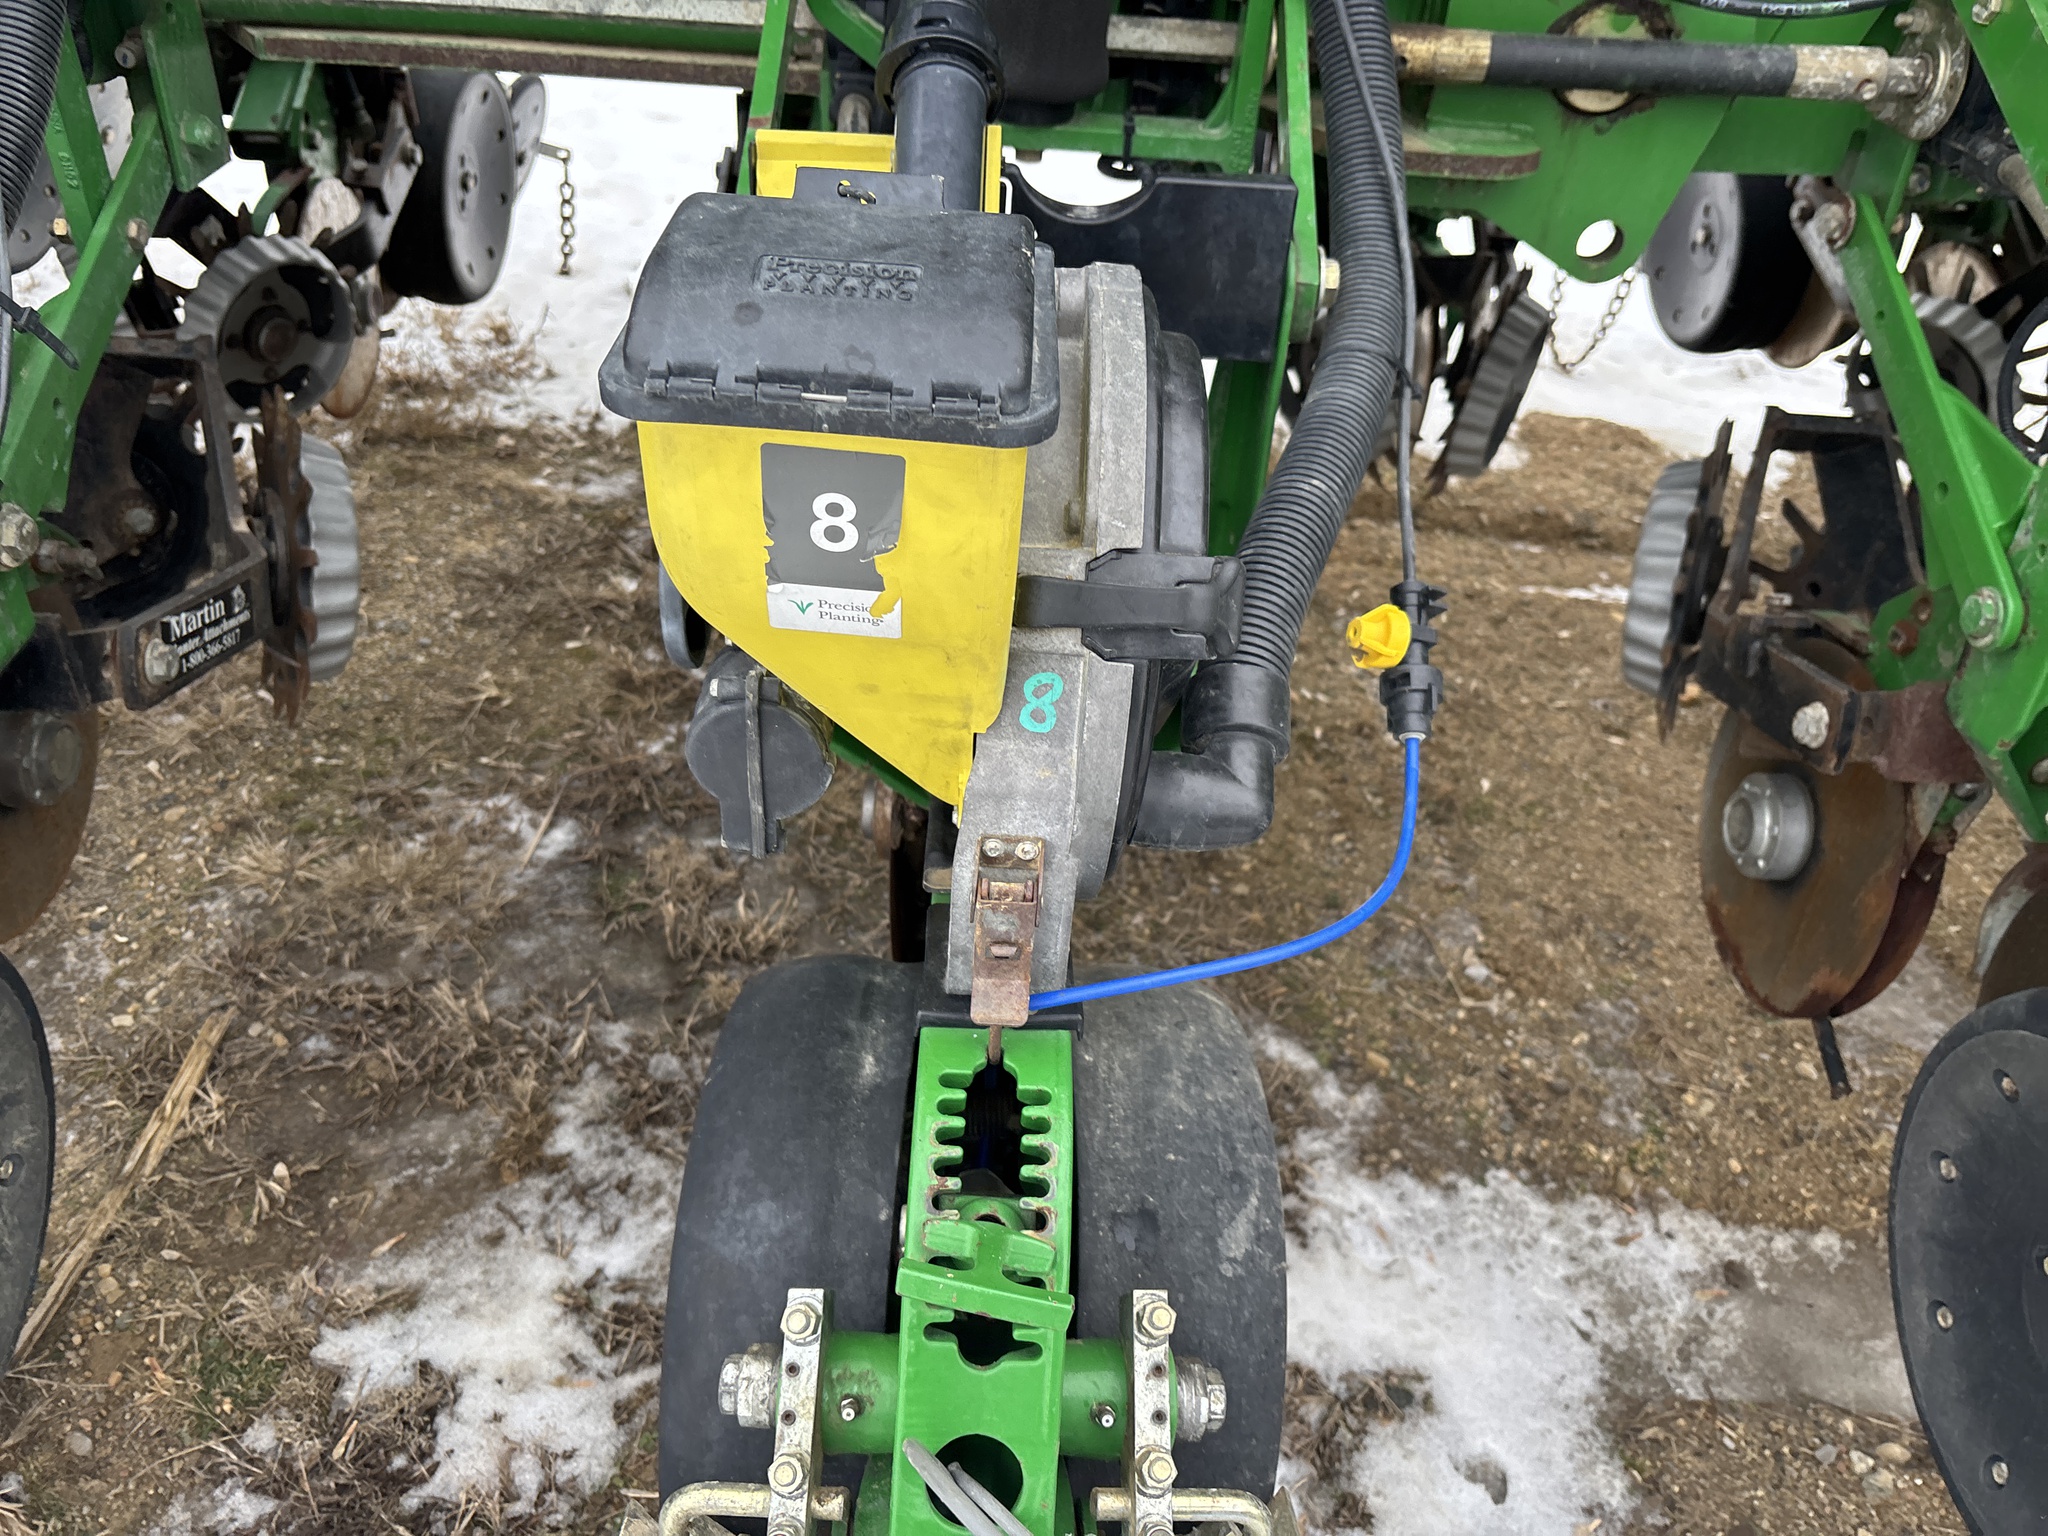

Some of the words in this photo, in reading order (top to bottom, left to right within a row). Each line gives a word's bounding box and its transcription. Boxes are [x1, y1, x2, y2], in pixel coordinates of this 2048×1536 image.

[767, 256, 917, 282] Precision
[762, 279, 913, 301] PLANTING
[809, 492, 859, 553] 8
[817, 599, 871, 613] Precisio
[818, 611, 881, 627] Planting
[169, 598, 226, 643] Martin
[1019, 672, 1064, 733] 8
